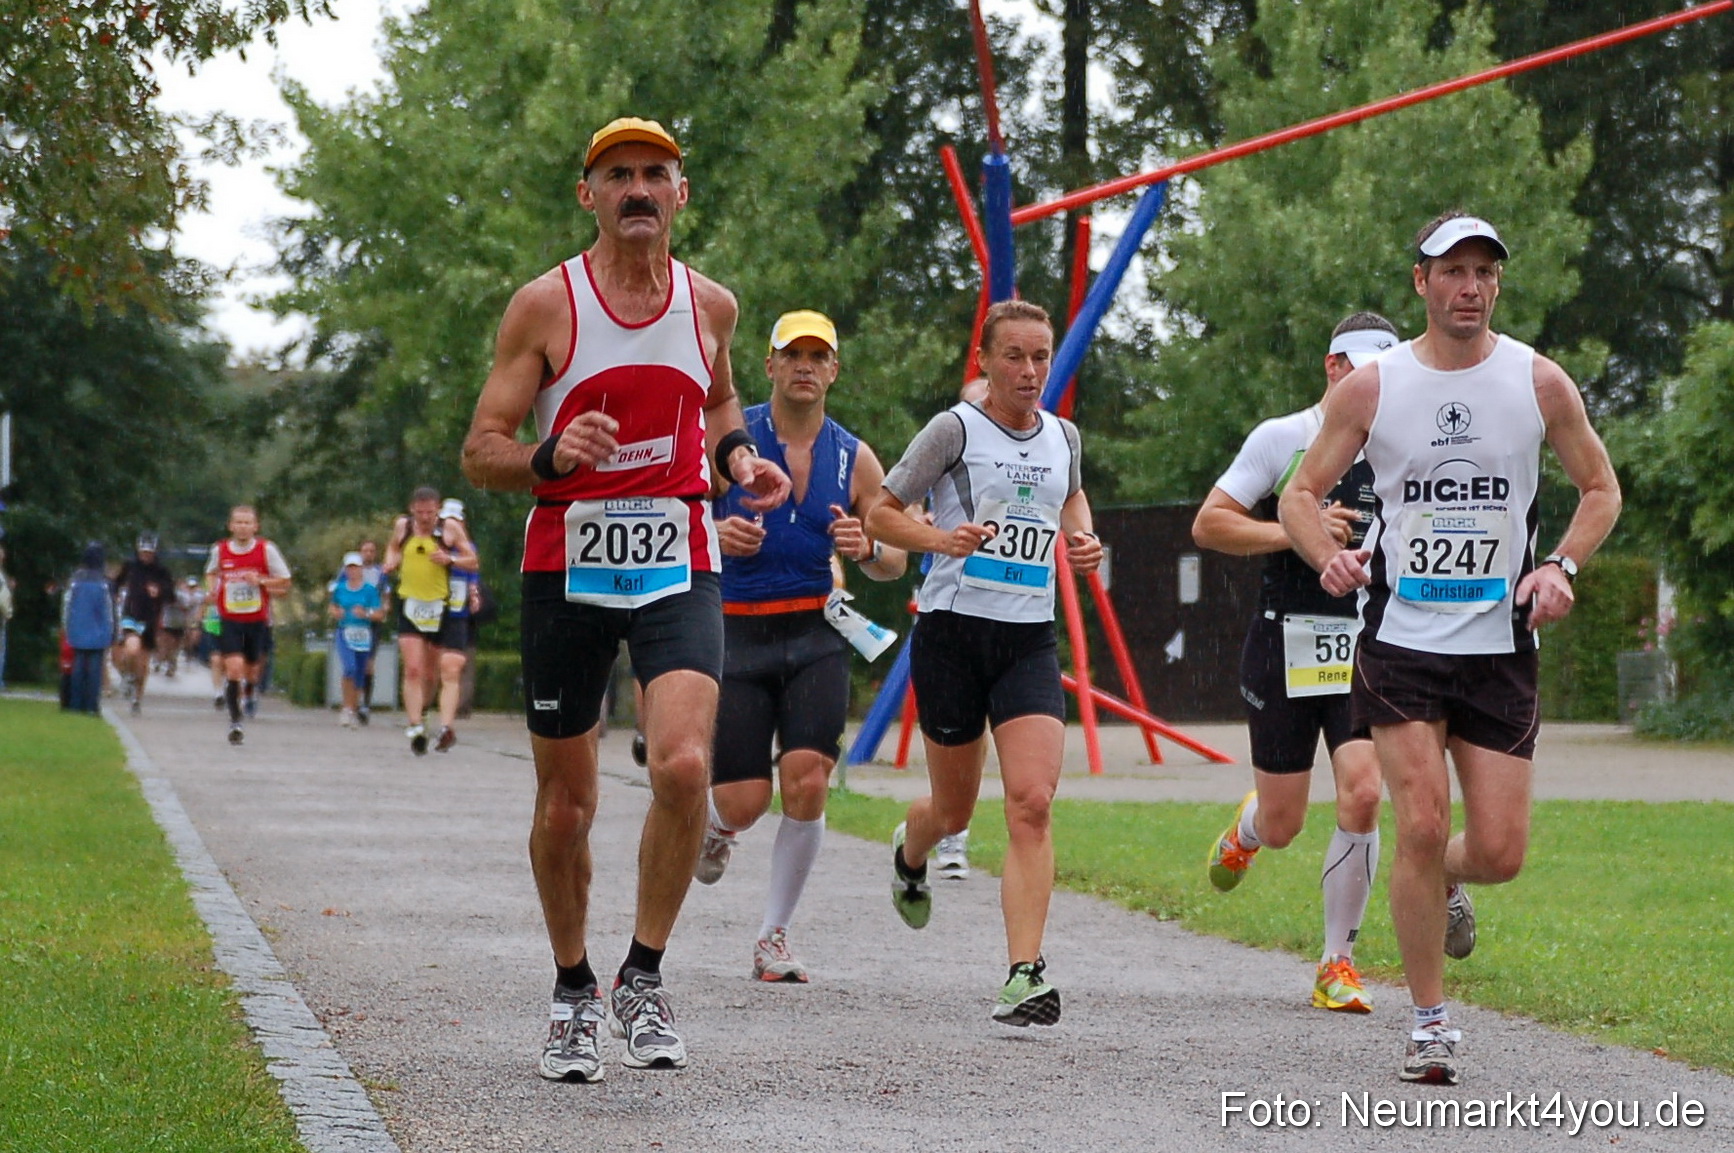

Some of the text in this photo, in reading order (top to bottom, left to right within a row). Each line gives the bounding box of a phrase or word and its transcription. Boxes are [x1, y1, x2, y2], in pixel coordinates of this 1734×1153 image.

[1431, 437, 1449, 447] ebf
[618, 447, 653, 463] DEHN
[1007, 471, 1045, 482] LANGE
[580, 522, 678, 565] 2032
[978, 520, 1055, 562] 2307
[1409, 538, 1500, 575] 3247
[1004, 566, 1023, 581] Evi
[613, 574, 644, 591] Karl
[1421, 583, 1484, 599] Christian
[1318, 671, 1348, 682] Rene
